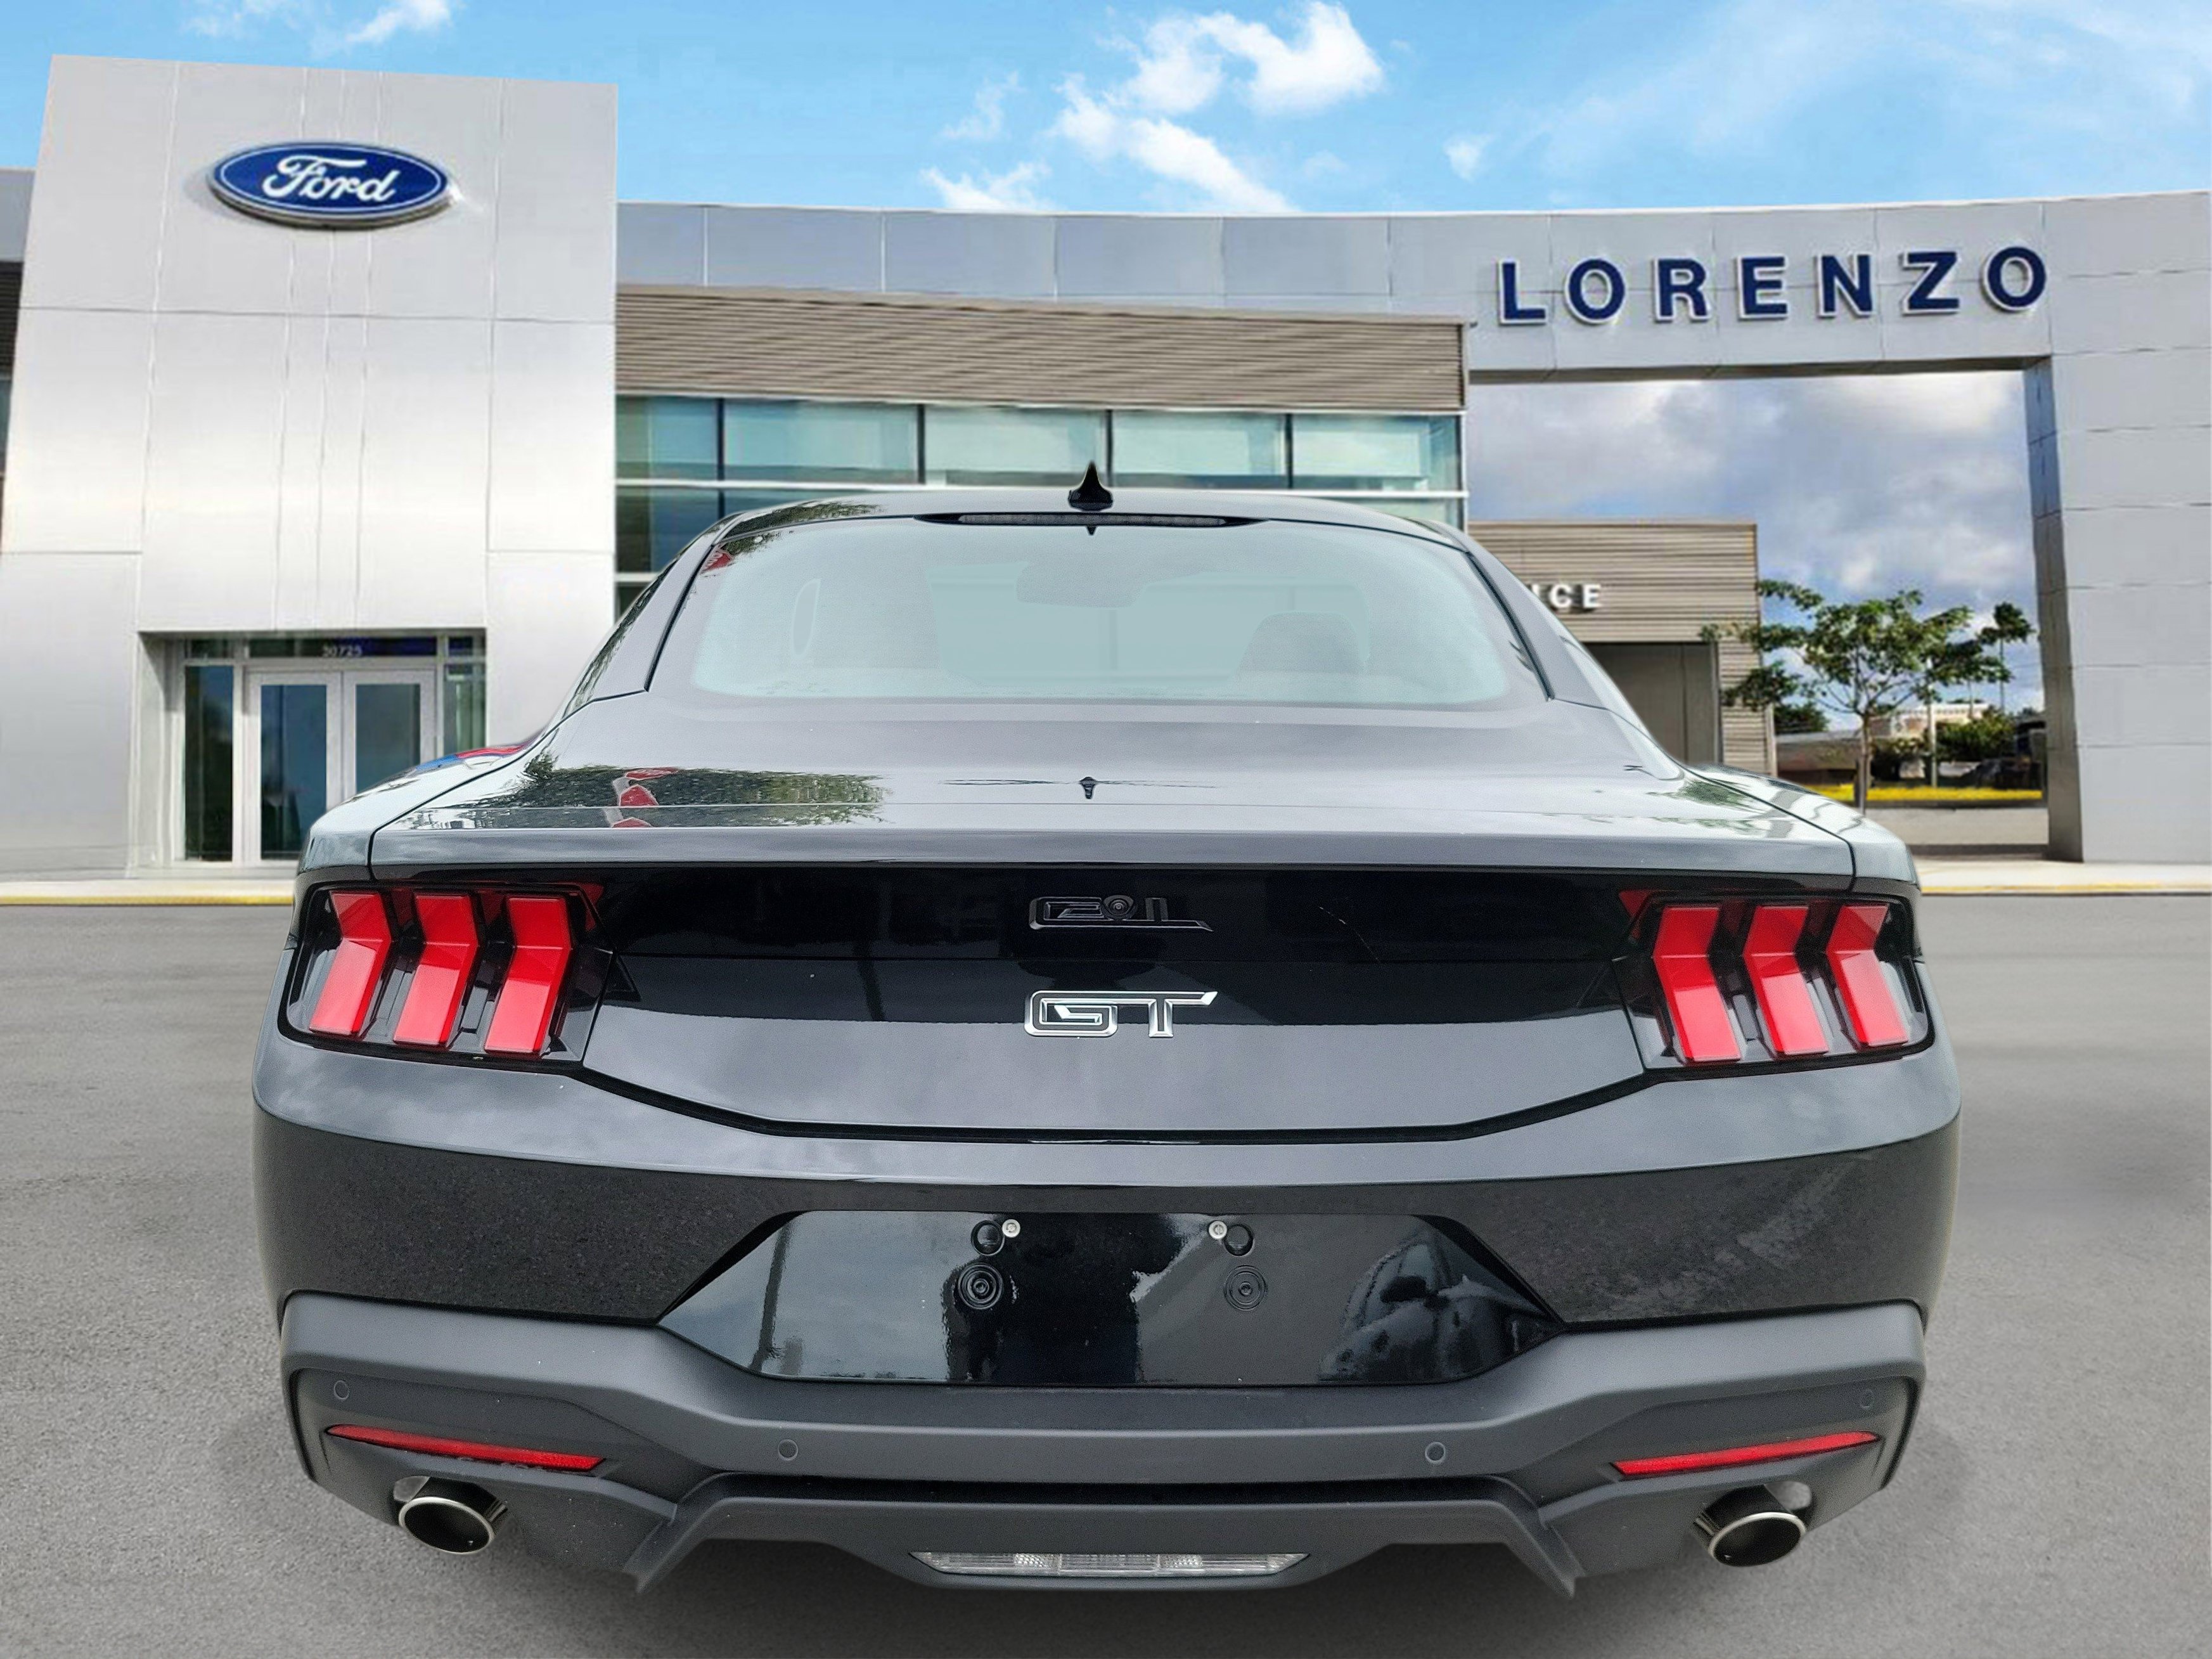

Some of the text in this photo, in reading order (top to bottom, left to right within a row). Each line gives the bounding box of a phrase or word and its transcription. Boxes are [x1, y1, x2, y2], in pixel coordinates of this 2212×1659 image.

[262, 154, 401, 202] Ford
[1495, 245, 2048, 325] LORENZO
[1024, 990, 1218, 1038] GT
